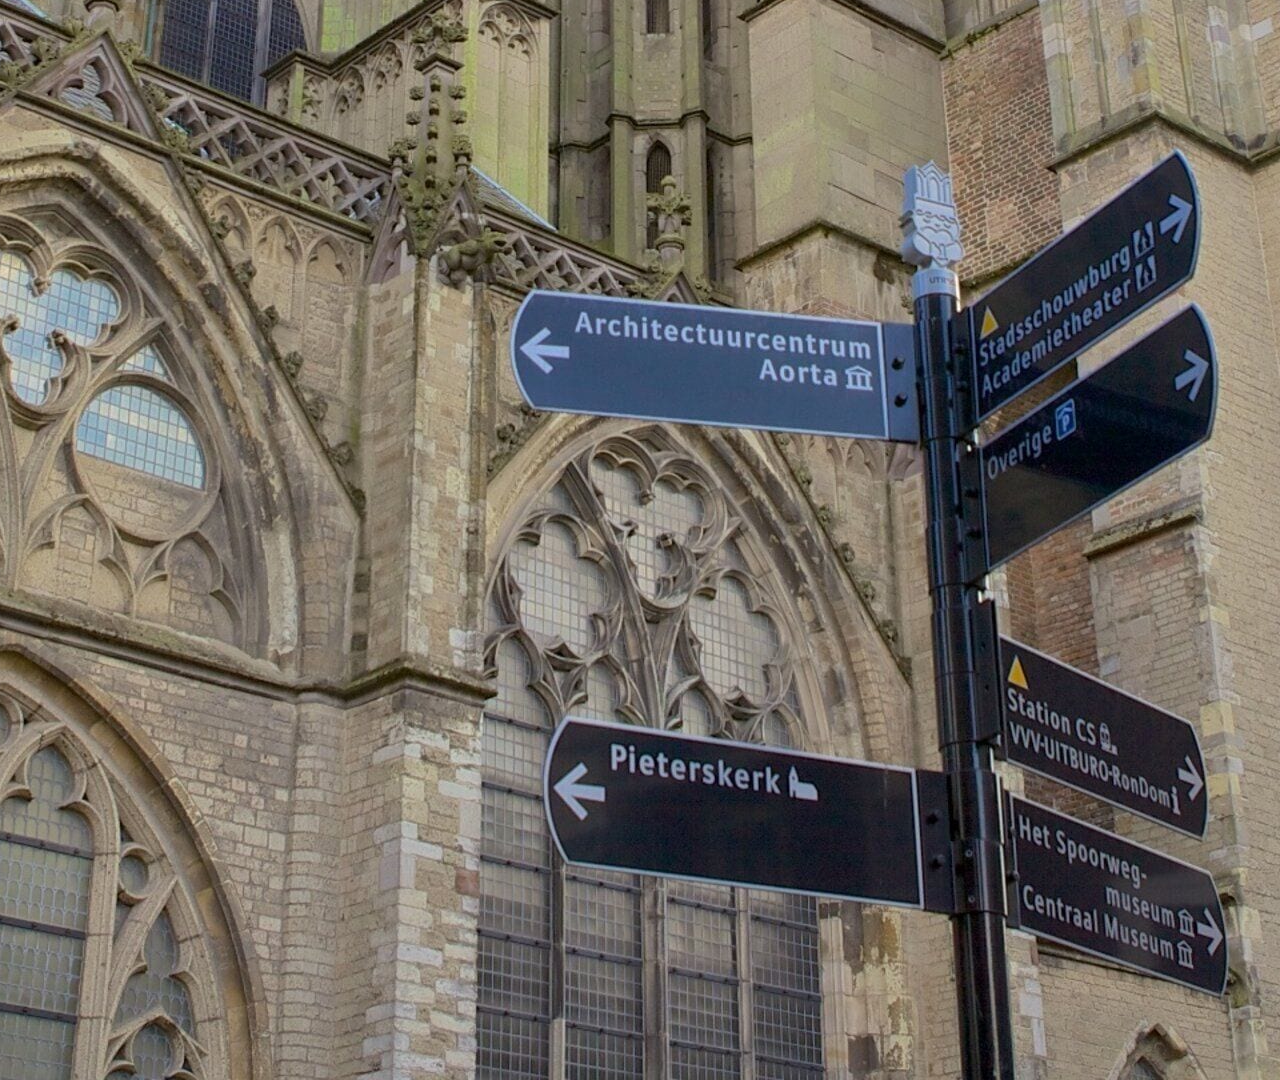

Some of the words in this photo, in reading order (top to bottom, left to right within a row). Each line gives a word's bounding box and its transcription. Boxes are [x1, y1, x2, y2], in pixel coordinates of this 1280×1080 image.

[979, 245, 1130, 367] Stadsschouwburg
[575, 311, 871, 359] Architectuurcentrum
[982, 278, 1131, 398] Academietheater
[759, 359, 837, 386] Aorta
[987, 425, 1052, 480] Overige
[1007, 688, 1071, 735] Station
[1075, 718, 1096, 746] CS
[610, 743, 781, 794] Pieterskerk
[1019, 814, 1051, 849] Het
[1056, 830, 1147, 889] Spoorweg-
[1023, 885, 1099, 934] Centraal
[1104, 913, 1174, 961] Museum
[1105, 886, 1176, 929] museum
